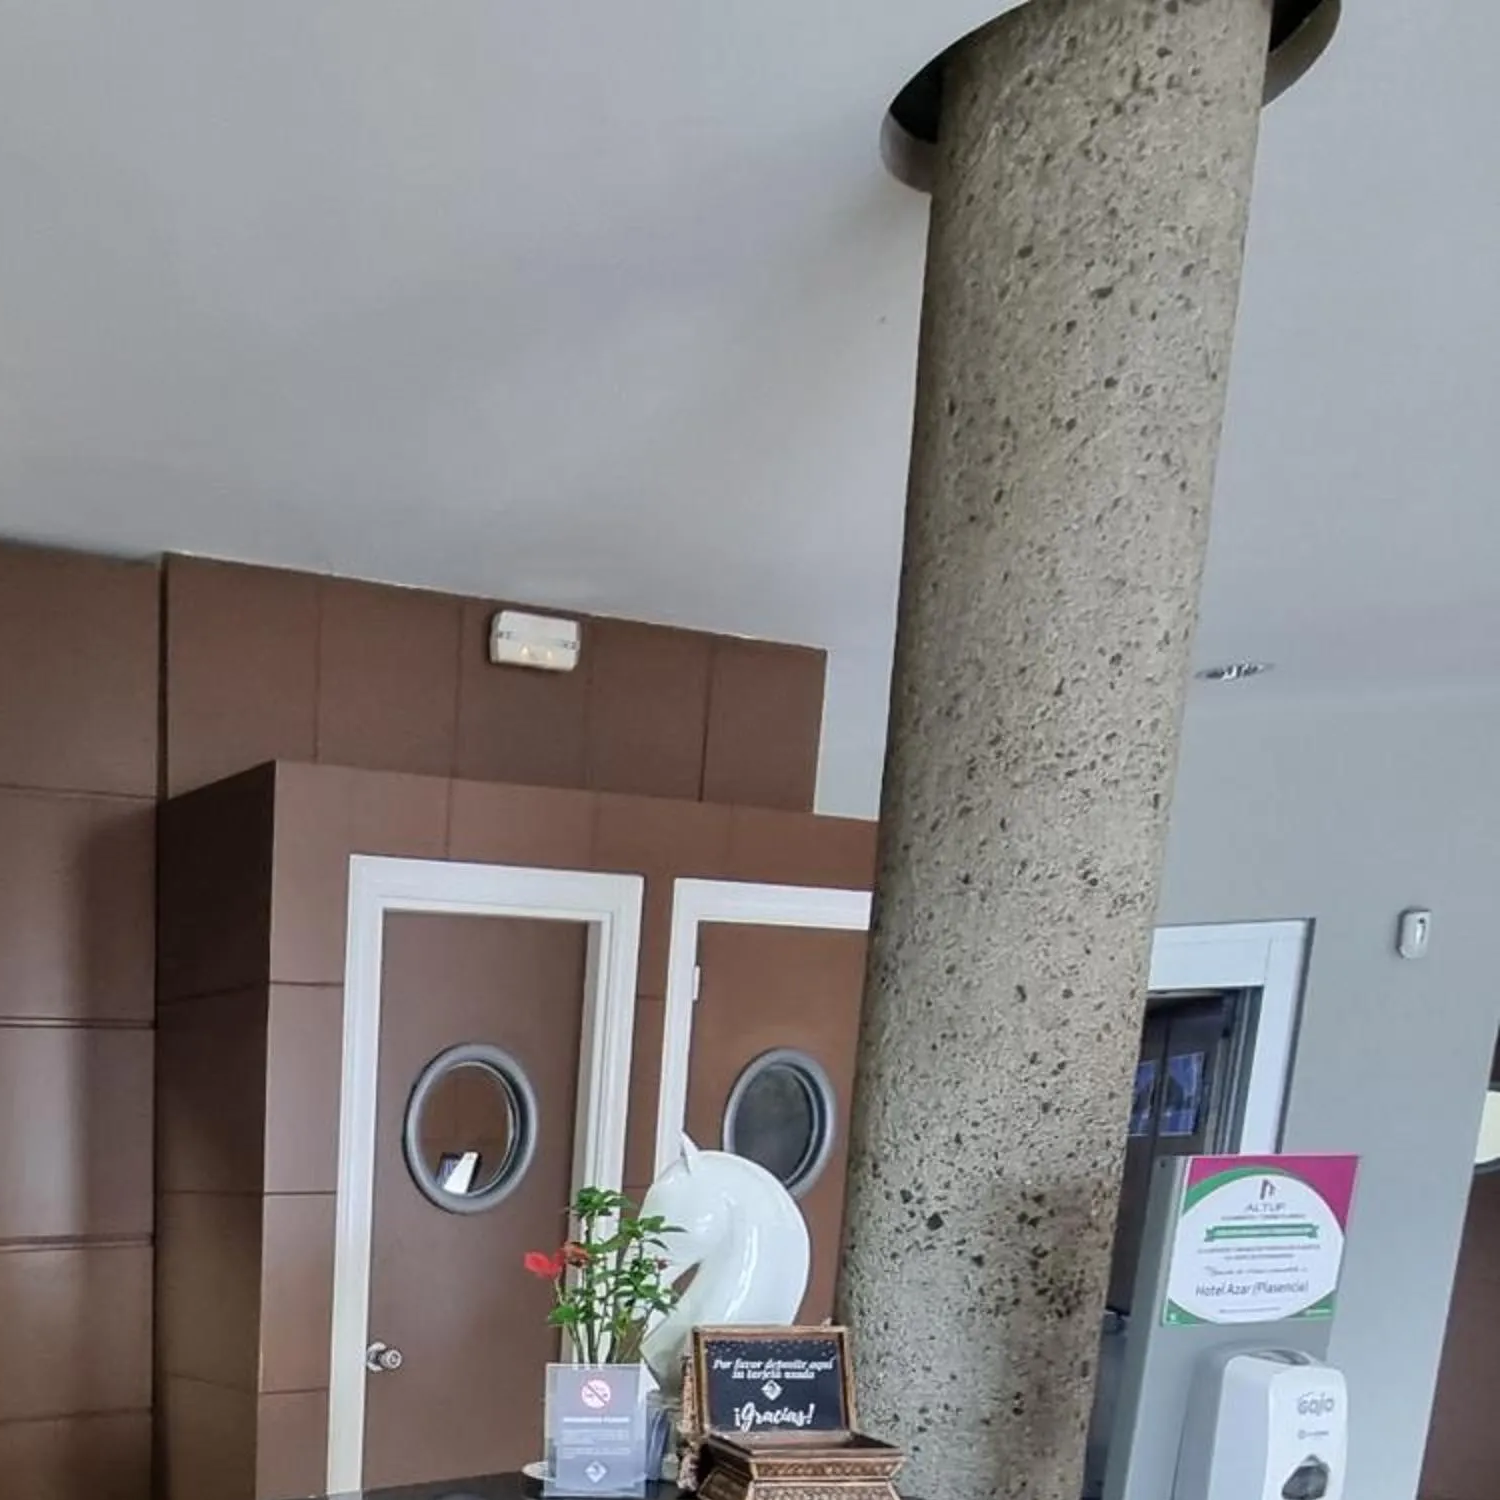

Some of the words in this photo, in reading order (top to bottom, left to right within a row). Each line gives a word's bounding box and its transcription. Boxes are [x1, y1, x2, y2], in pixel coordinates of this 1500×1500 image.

[1196, 1281, 1225, 1296] Hotel
[1226, 1280, 1250, 1295] Azar
[733, 1401, 816, 1432] ¡Gracias!
